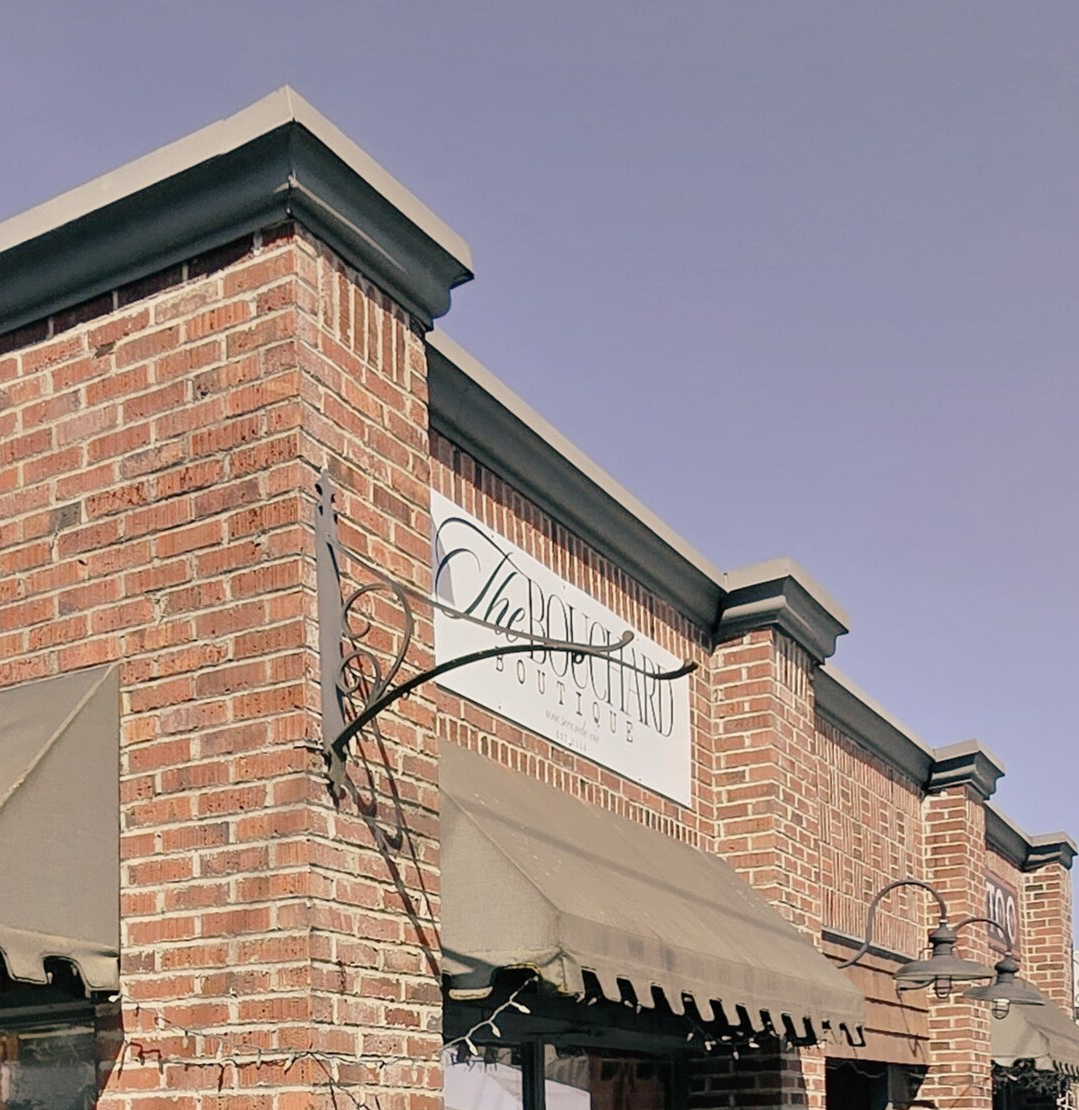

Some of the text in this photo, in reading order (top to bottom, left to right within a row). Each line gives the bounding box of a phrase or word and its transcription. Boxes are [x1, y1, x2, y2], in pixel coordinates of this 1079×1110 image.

[434, 517, 674, 738] The BOUCHARD
[495, 646, 634, 744] BOUTIQUE
